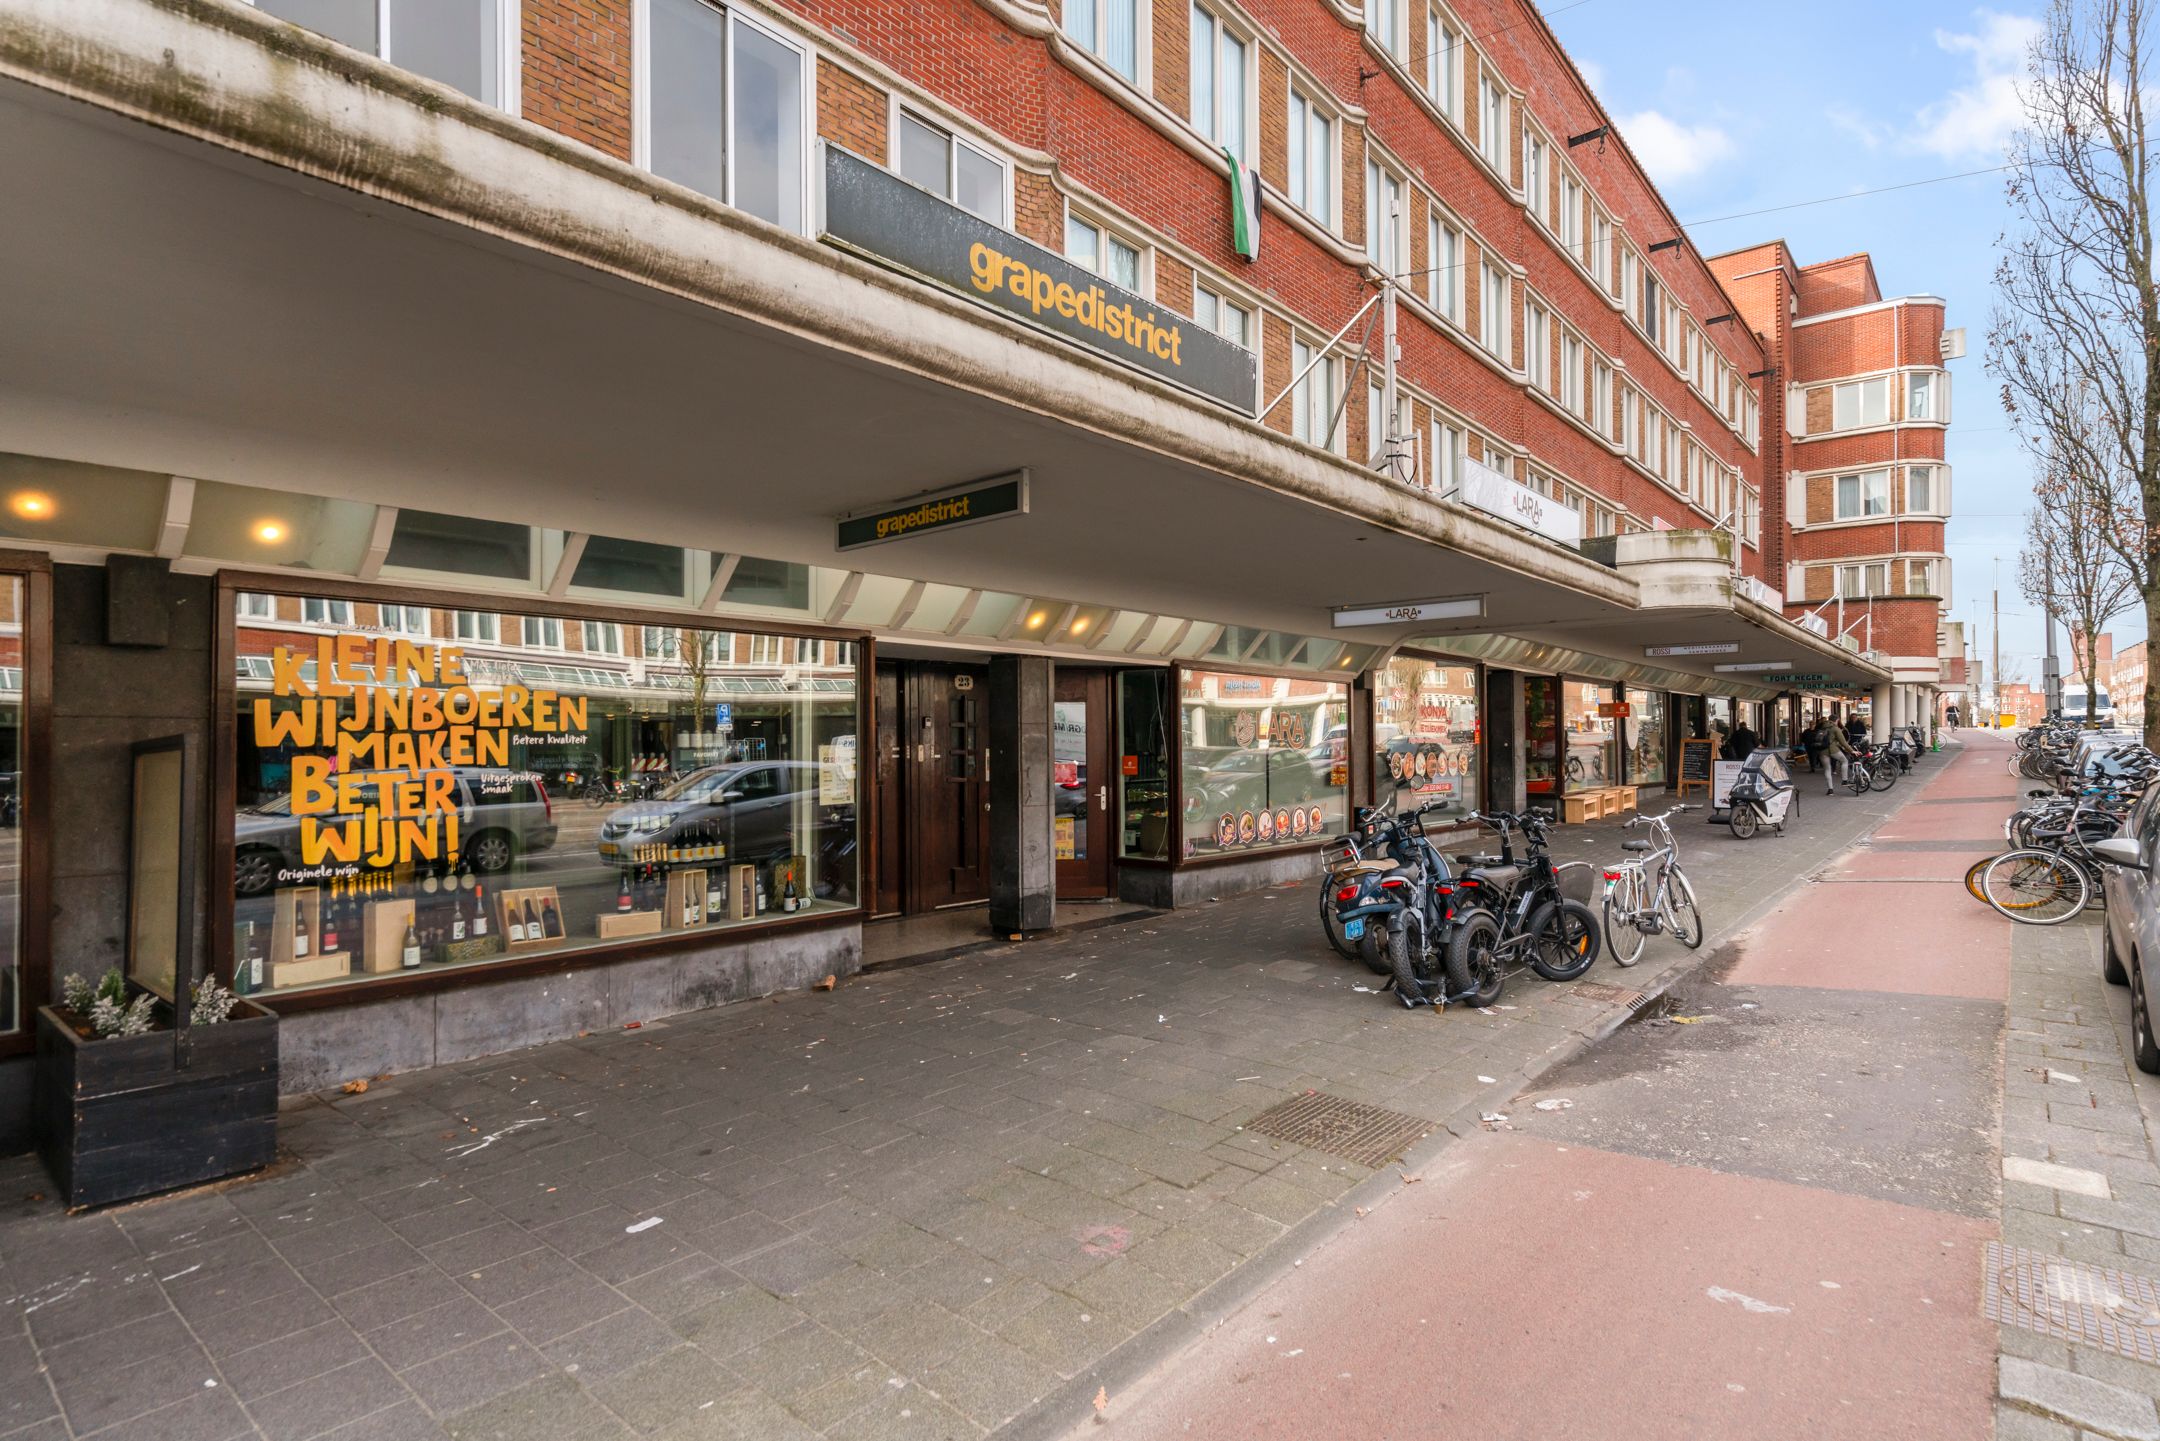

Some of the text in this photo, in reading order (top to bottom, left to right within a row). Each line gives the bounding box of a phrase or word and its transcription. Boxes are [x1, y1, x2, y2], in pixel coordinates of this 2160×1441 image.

[969, 241, 1182, 367] grapedistrict
[876, 495, 970, 539] grapedistrict
[1515, 490, 1541, 525] LARA
[1388, 607, 1418, 621] LARA
[1652, 647, 1672, 656] ROSSI
[273, 634, 467, 697] KLEINE
[1769, 674, 1791, 682] FORT
[957, 676, 970, 688] 23
[254, 684, 588, 747] WIJNBOEREN
[1420, 705, 1448, 719] KONYA
[512, 733, 588, 746] Betere kwaliteit
[1255, 711, 1305, 750] LARA
[337, 725, 509, 779] MAKEN
[290, 755, 459, 817] BETER
[480, 770, 543, 787] Uitgesproken
[480, 783, 513, 795] Smaak
[301, 806, 460, 871] WIJN!
[277, 863, 360, 883] Originele wijn
